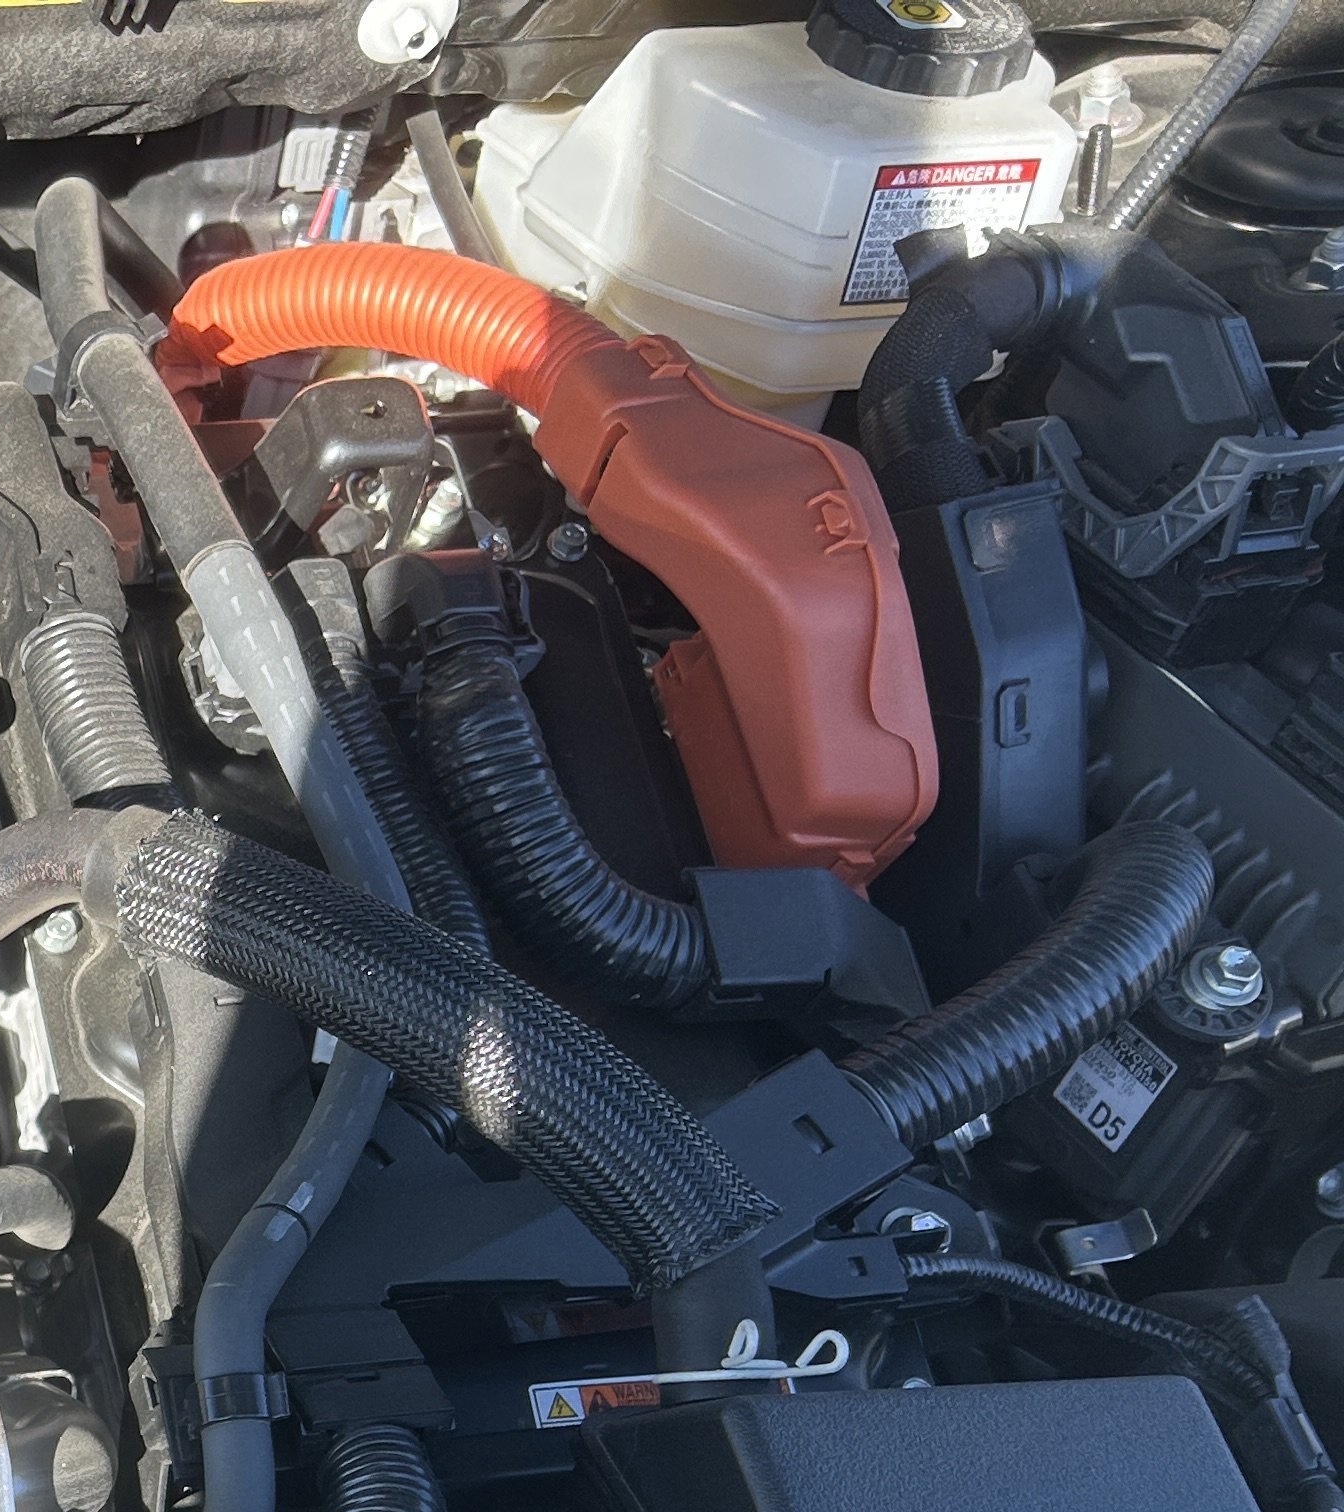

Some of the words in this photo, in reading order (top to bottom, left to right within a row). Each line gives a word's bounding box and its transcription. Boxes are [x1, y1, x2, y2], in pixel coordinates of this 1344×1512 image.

[931, 165, 995, 184] DANGER
[1115, 1036, 1153, 1077] TOYOTA
[1088, 1100, 1126, 1141] D5
